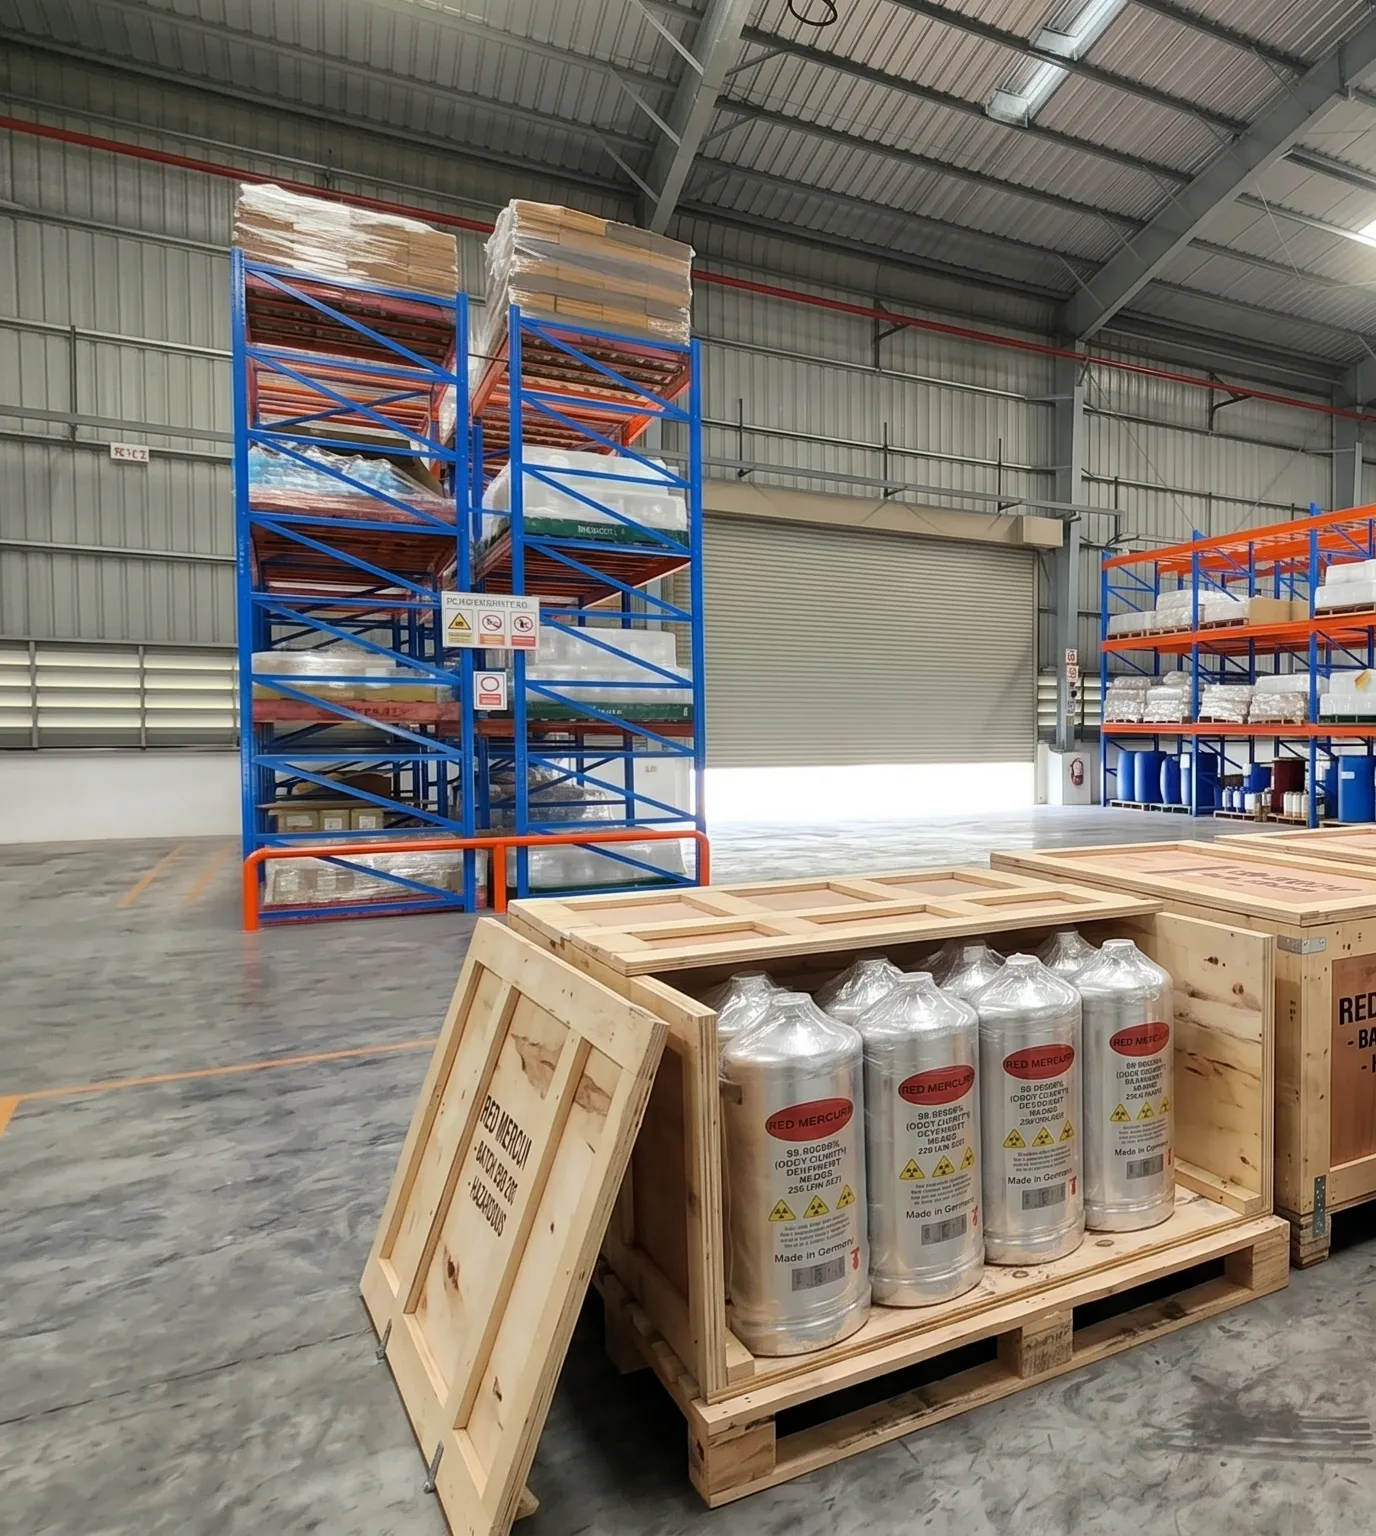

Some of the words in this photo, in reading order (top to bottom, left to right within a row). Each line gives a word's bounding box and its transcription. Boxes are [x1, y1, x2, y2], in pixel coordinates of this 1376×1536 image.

[1113, 1038, 1133, 1047] RED
[1006, 1060, 1028, 1069] RED
[902, 1085, 925, 1094] RED
[479, 1094, 501, 1134] RED
[769, 1120, 794, 1130] RED
[1034, 1175, 1042, 1183] in
[906, 1210, 932, 1219] Made
[934, 1207, 943, 1215] in
[774, 1253, 803, 1263] Made
[806, 1251, 816, 1259] in
